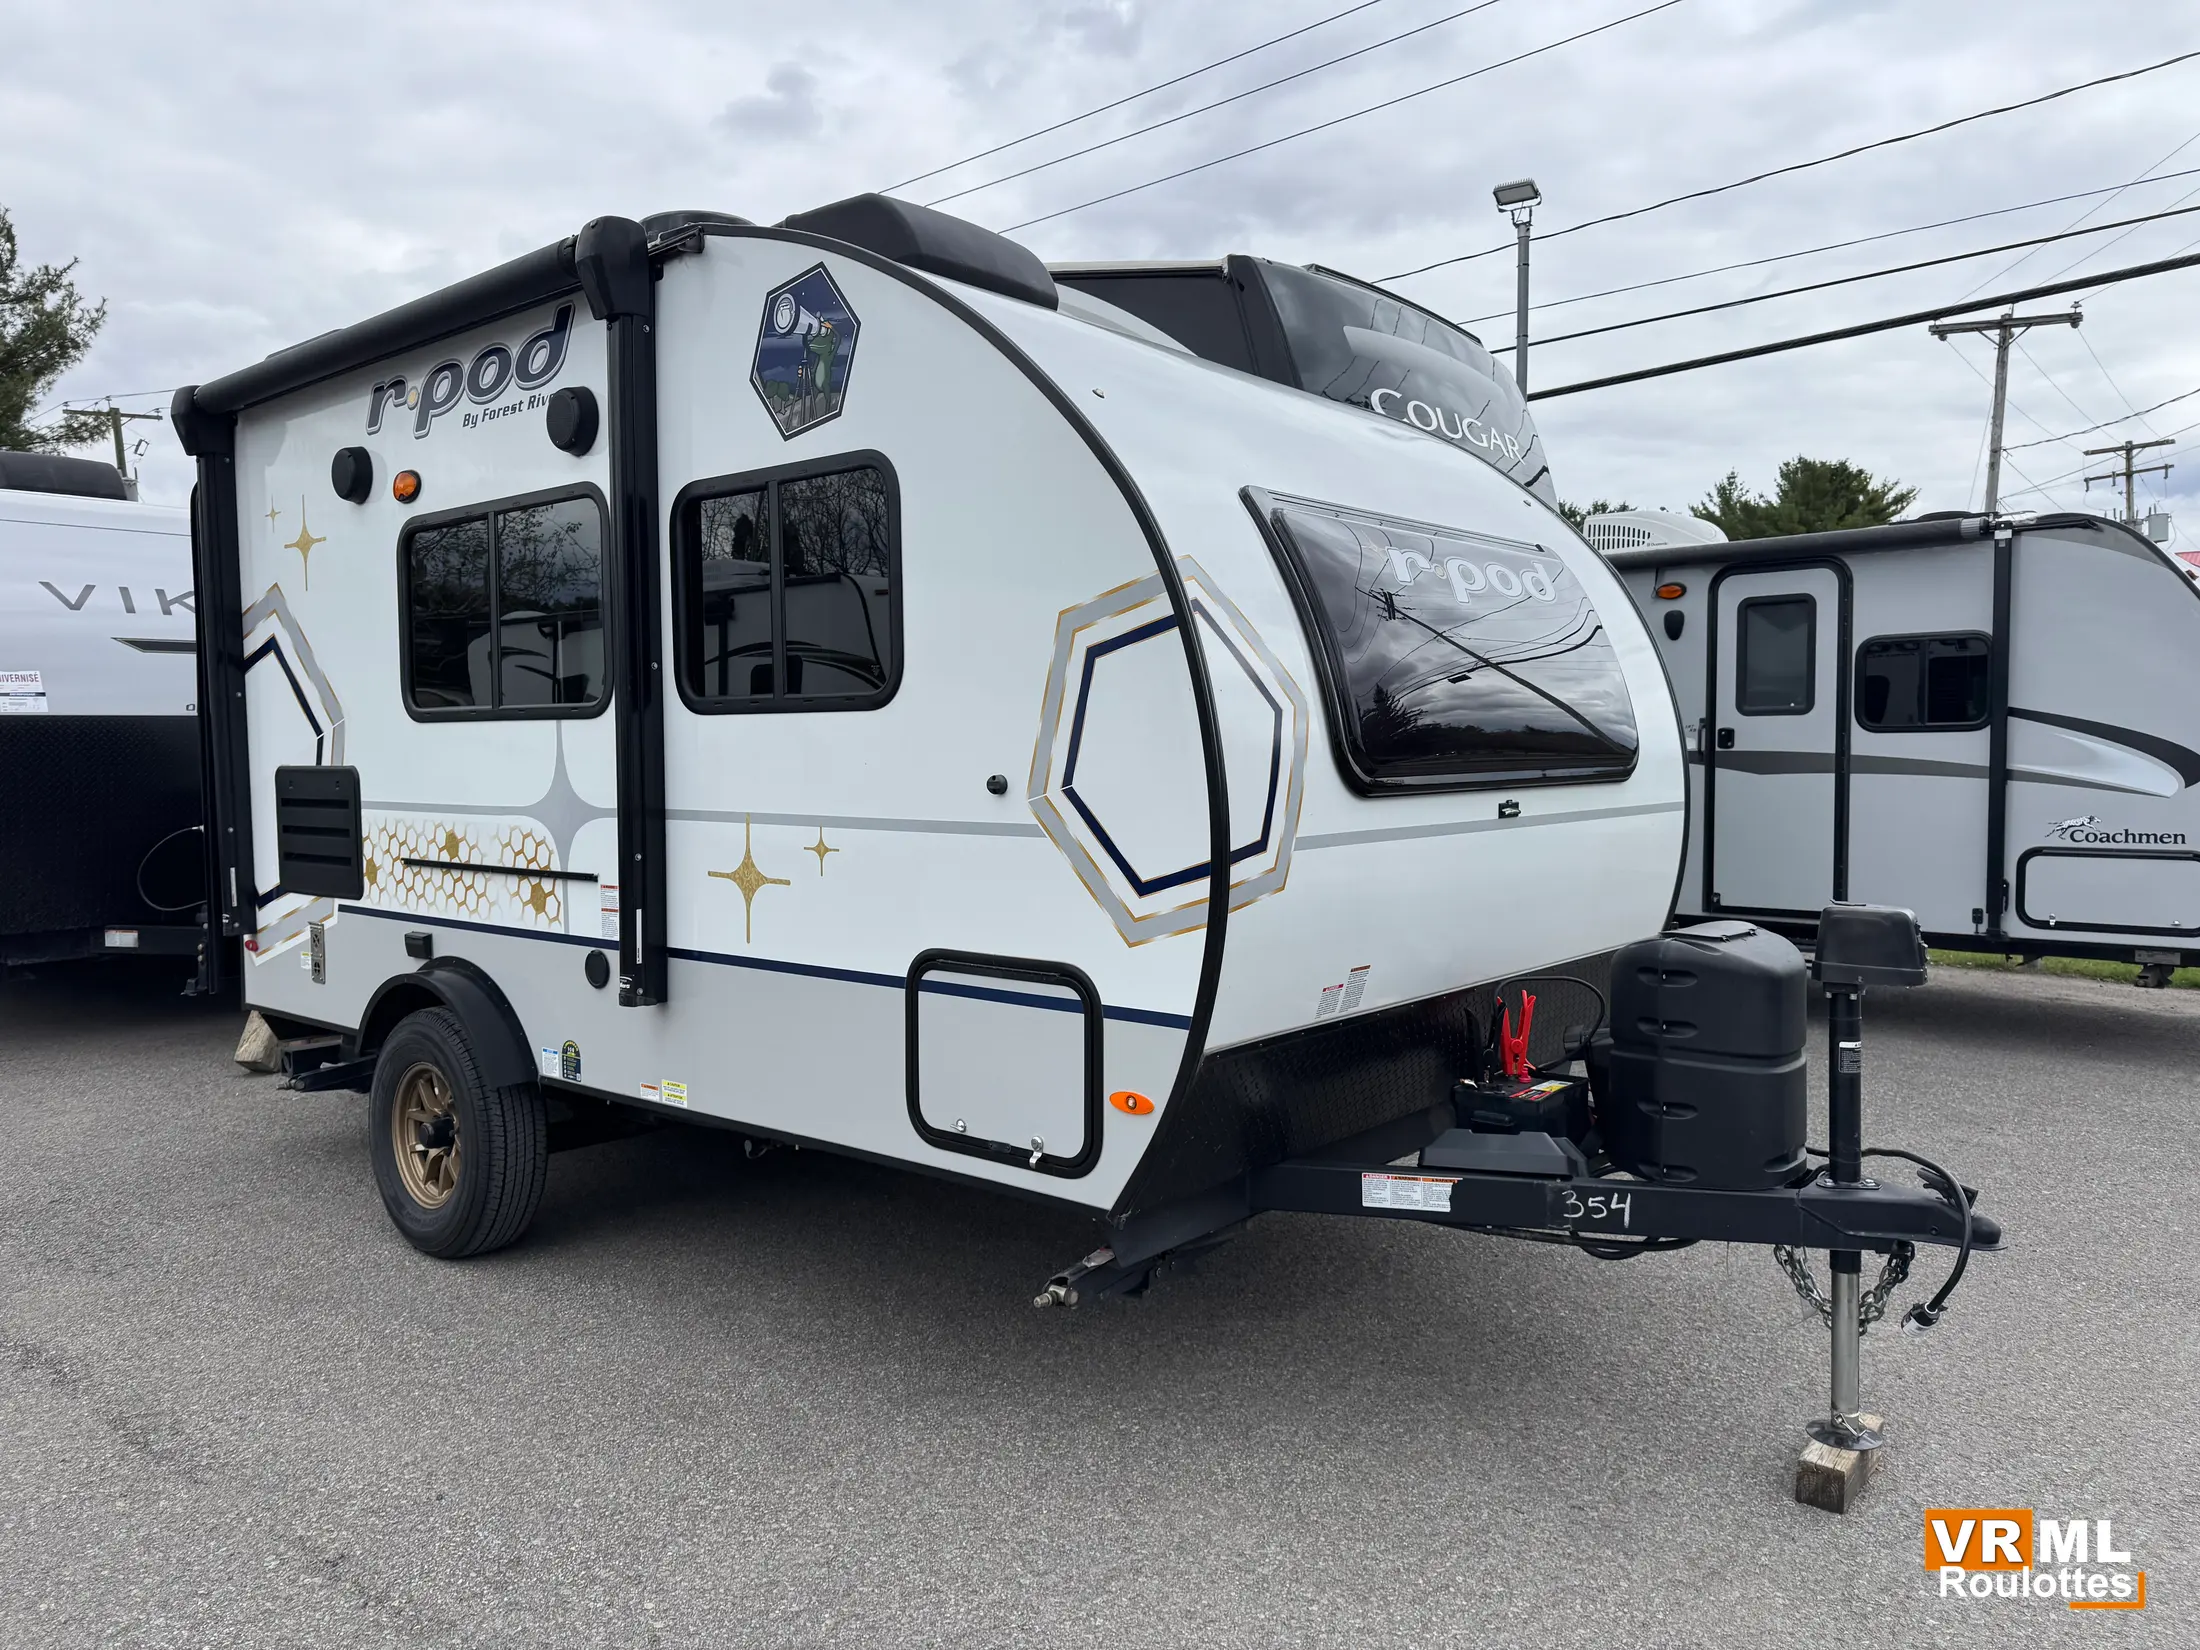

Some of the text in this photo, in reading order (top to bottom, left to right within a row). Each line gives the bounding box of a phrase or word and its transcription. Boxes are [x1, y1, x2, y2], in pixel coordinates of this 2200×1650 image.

[463, 392, 554, 429] By Forest Riv
[1371, 388, 1526, 465] COUGAR
[2069, 829, 2186, 844] Coachmen
[1562, 1190, 1631, 1228] 354
